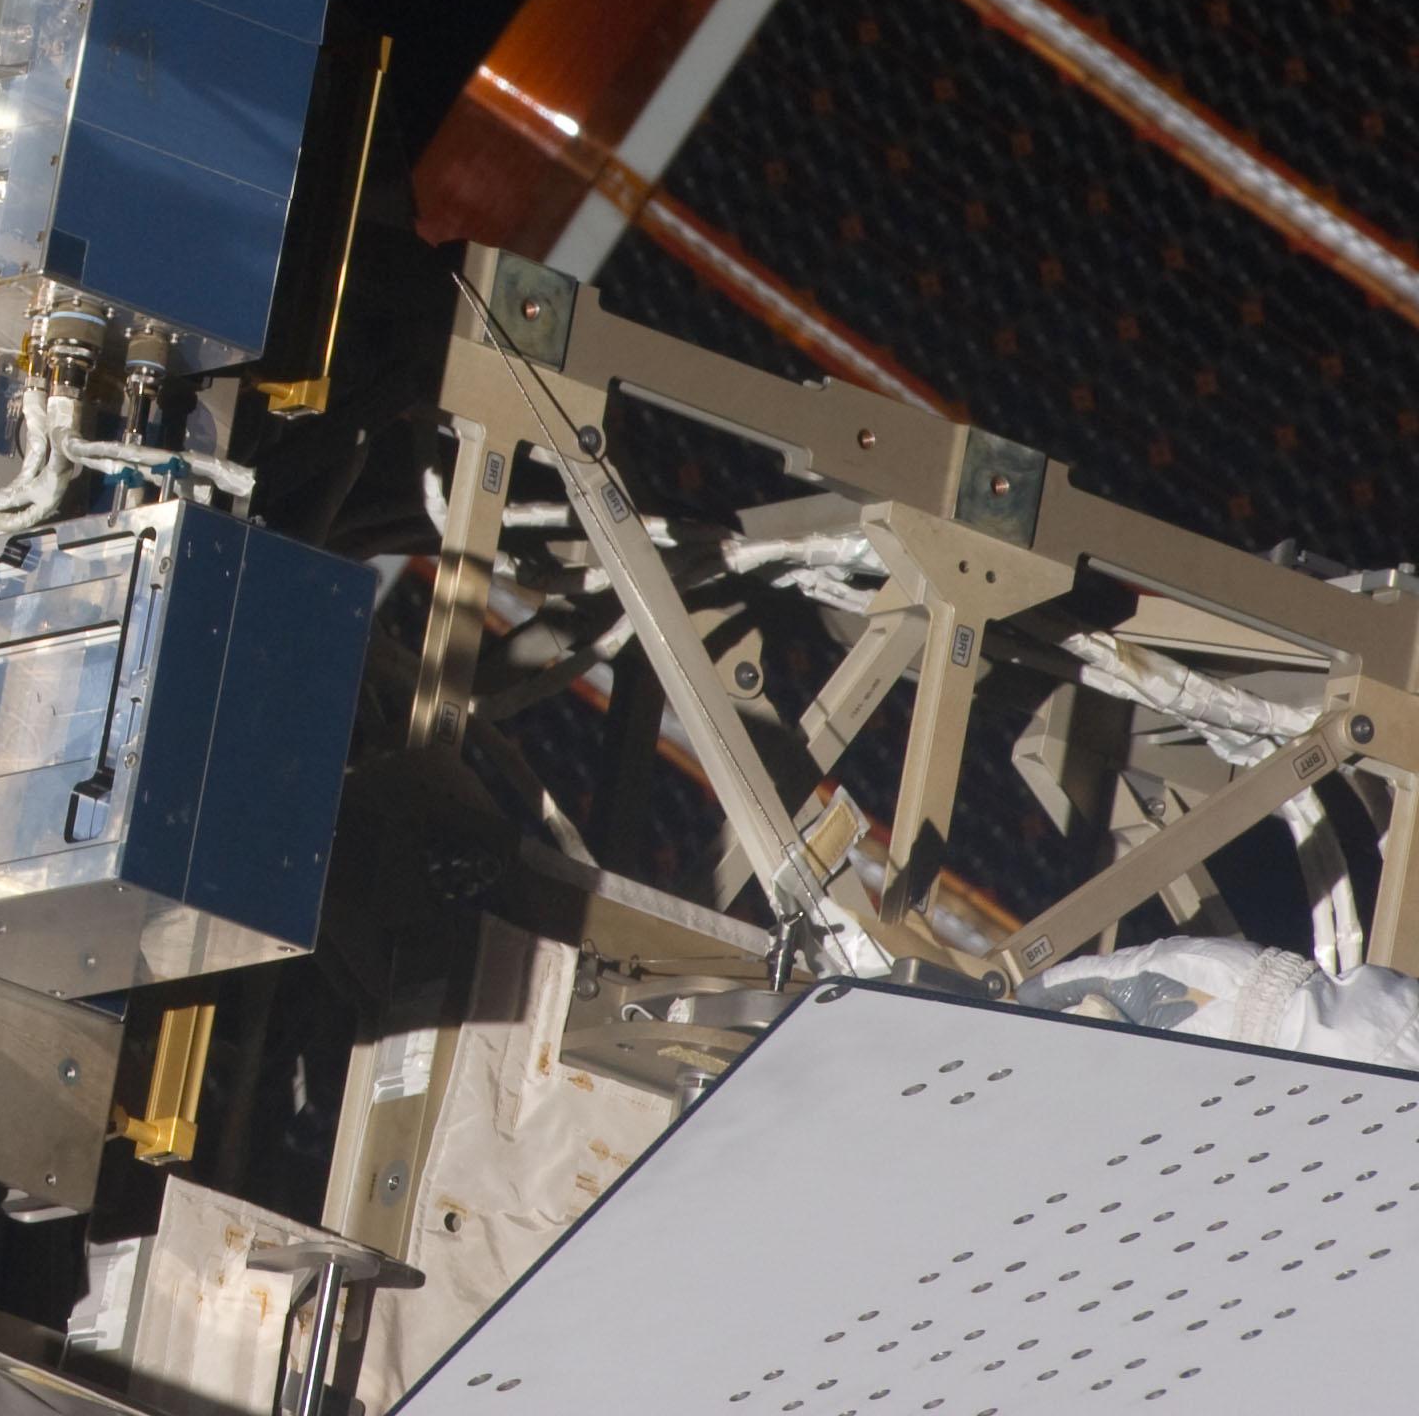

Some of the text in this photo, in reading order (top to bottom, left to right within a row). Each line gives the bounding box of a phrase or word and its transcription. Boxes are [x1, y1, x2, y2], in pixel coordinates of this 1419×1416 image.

[487, 459, 500, 487] BRT
[607, 489, 624, 515] BRT
[954, 631, 970, 660] BRT
[1297, 753, 1321, 773] BRT
[1026, 941, 1048, 962] BRT
